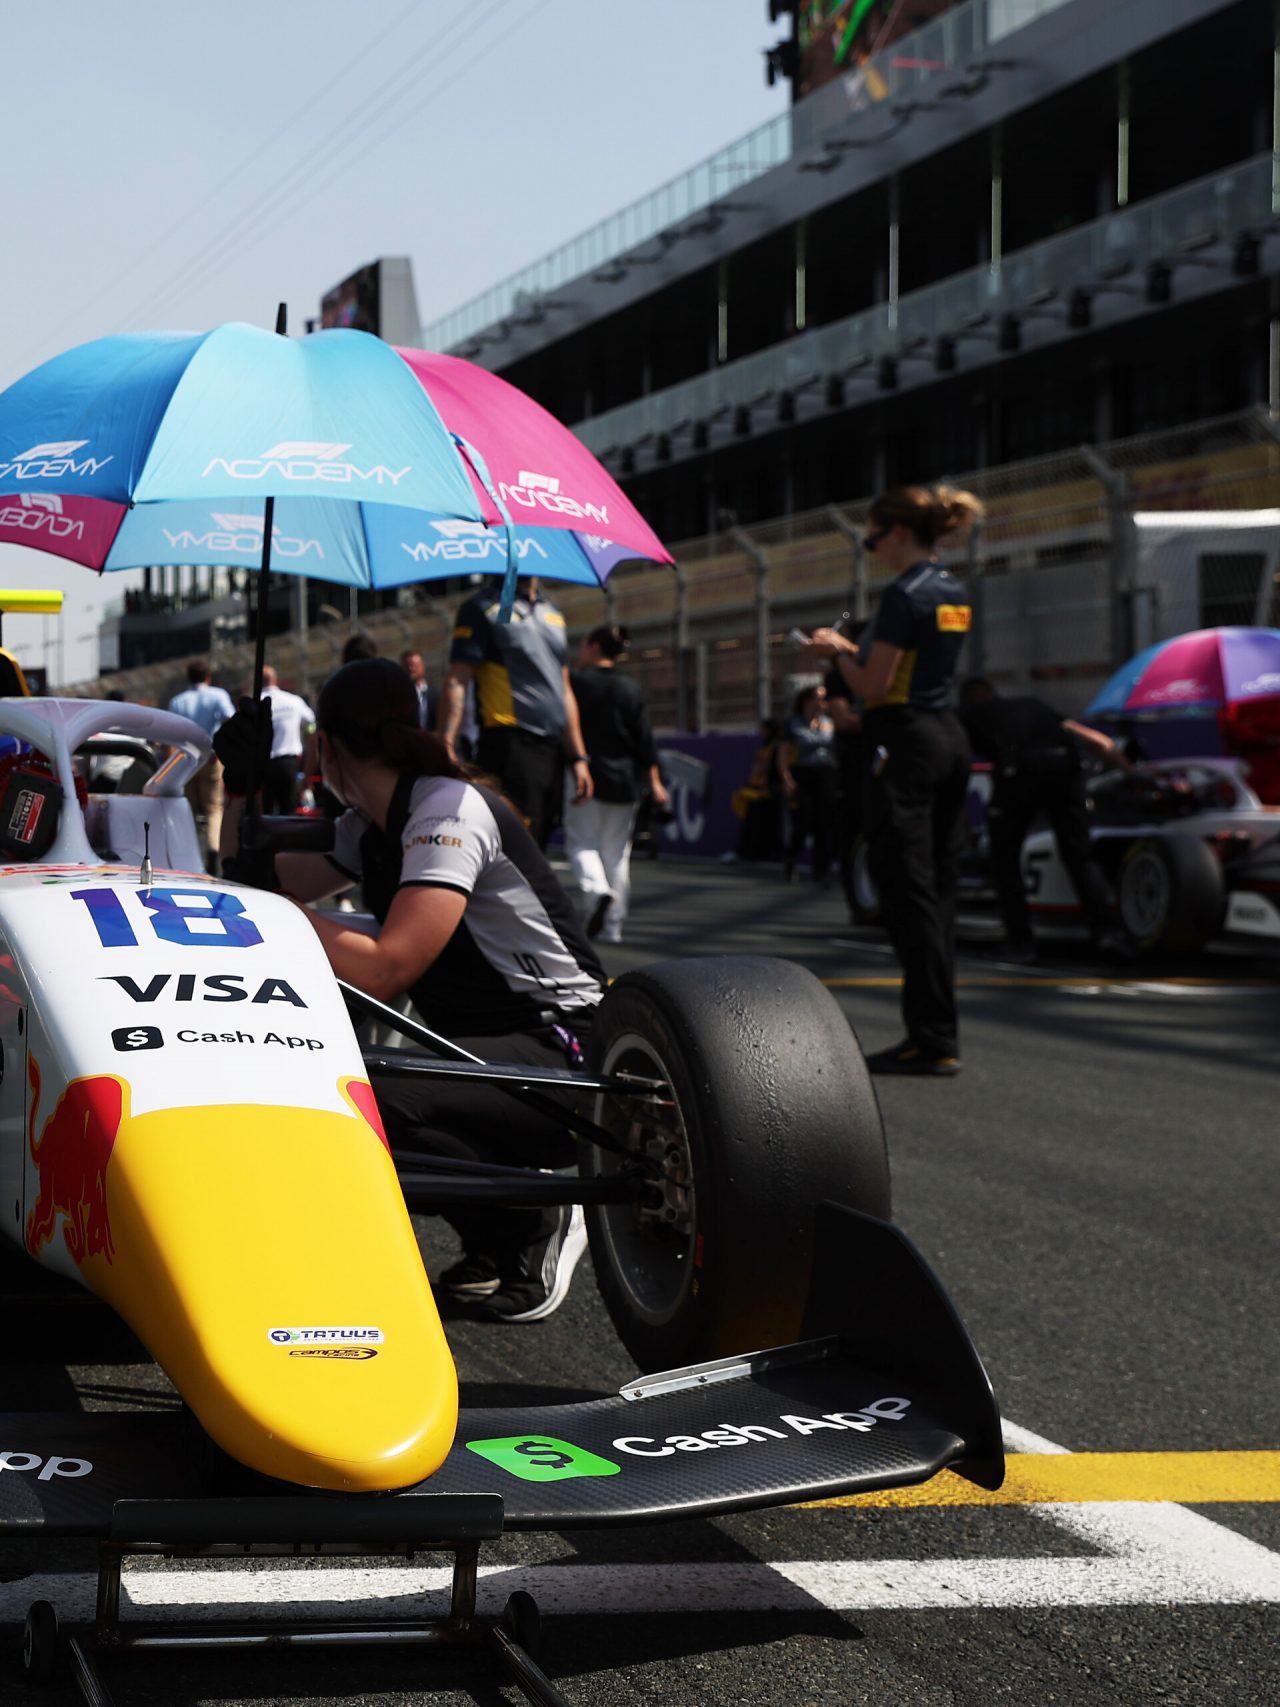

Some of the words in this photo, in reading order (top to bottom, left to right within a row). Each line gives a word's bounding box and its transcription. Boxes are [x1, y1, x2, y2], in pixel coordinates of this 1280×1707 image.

[202, 457, 412, 485] ACADEMY
[498, 481, 609, 524] ACADEMY
[70, 887, 264, 947] 18
[95, 974, 308, 1008] VISA
[177, 1030, 254, 1044] Cash
[263, 1032, 324, 1050] App
[301, 1330, 379, 1338] TATUUS
[613, 1424, 787, 1457] Cash
[780, 1397, 911, 1434] App
